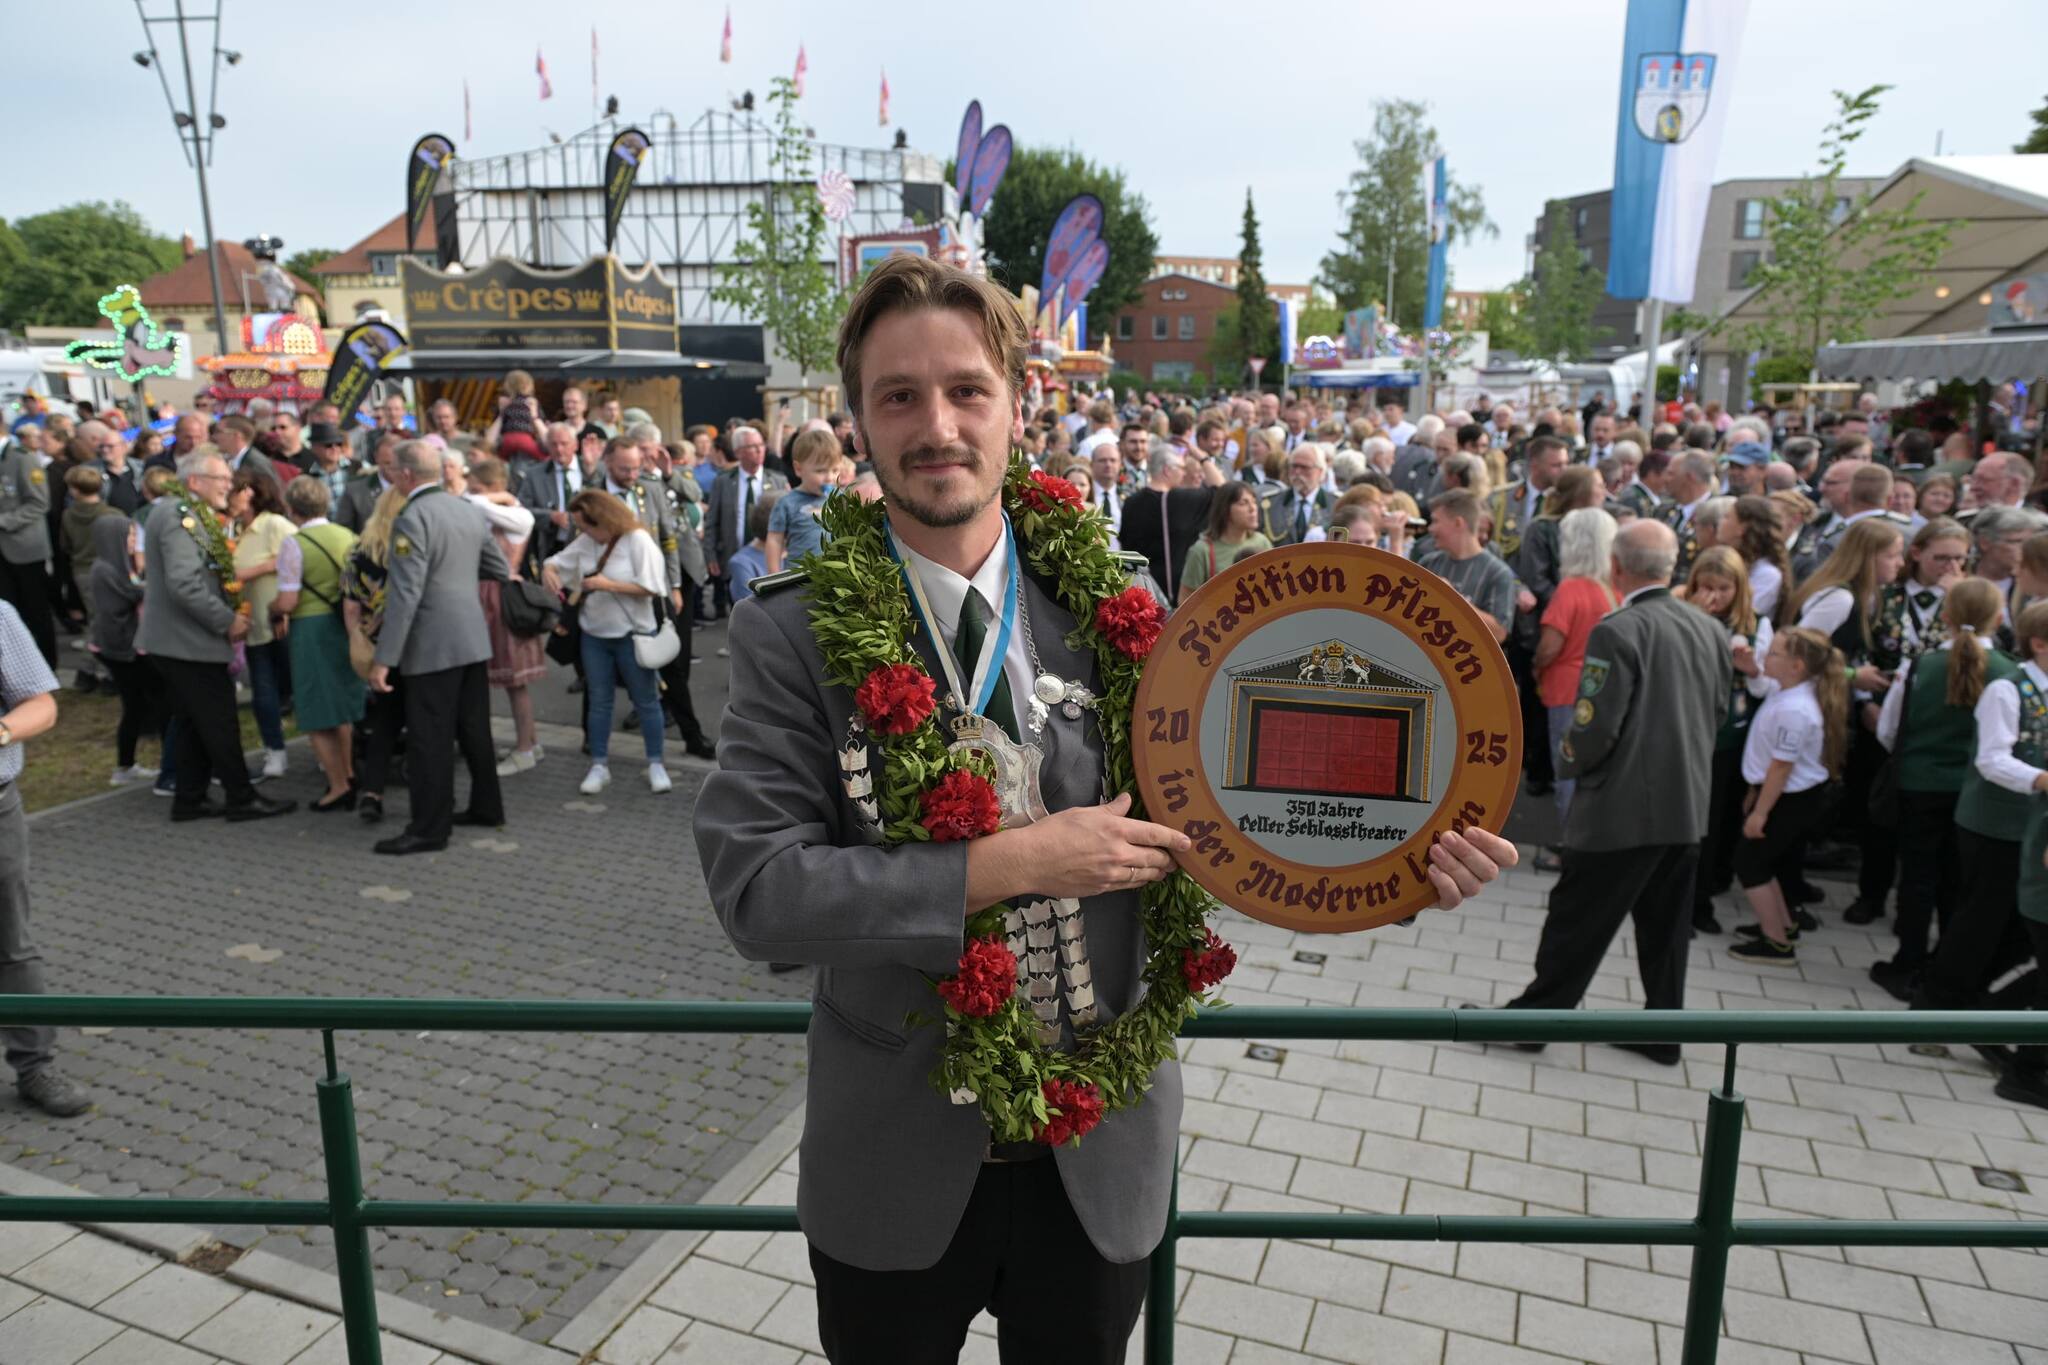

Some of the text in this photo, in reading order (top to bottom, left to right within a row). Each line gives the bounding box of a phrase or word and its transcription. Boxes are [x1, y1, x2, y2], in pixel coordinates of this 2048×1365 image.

[442, 278, 573, 320] Crêpes
[1178, 561, 1347, 667] Tradition
[1146, 707, 1190, 744] 20
[1465, 729, 1509, 767] 25
[1238, 813, 1407, 841] Celler Schlosstheater
[1286, 799, 1364, 818] 350 Jahre
[1157, 768, 1195, 813] in
[1183, 819, 1235, 868] der
[1235, 860, 1401, 913] Moderne
